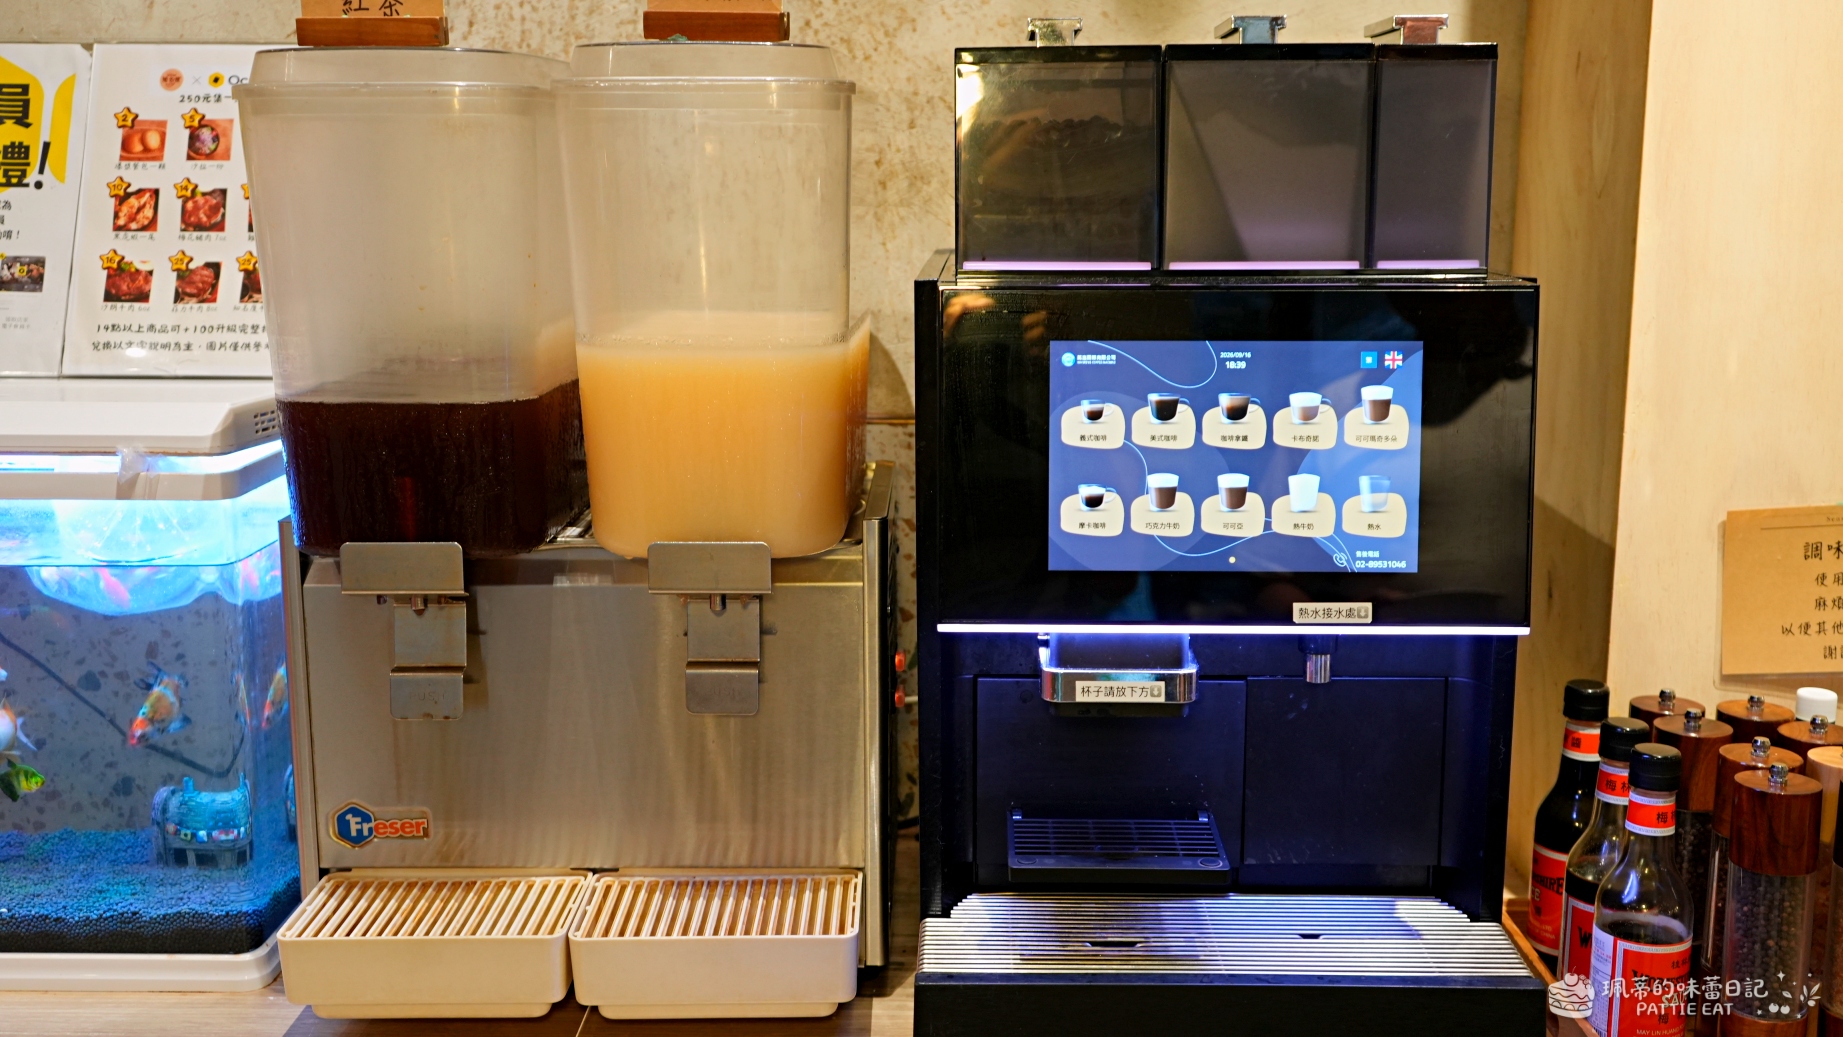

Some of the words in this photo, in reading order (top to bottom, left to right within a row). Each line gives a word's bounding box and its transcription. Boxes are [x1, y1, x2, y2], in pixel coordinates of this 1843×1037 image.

[179, 94, 233, 103] 250元集一
[105, 256, 116, 264] 16
[174, 257, 184, 265] 25
[1225, 361, 1247, 369] 18:39
[1080, 434, 1107, 442] 義式咖啡
[1150, 434, 1178, 442] 美式咖啡
[1220, 434, 1249, 442] 咖啡拿鐵
[1291, 435, 1320, 443] 卡布奇諾
[1078, 522, 1107, 530] 摩卡咖啡
[1145, 522, 1180, 530] 巧克力牛奶
[1222, 522, 1244, 530] 可可亞
[1293, 523, 1315, 531] 熱牛奶
[1367, 523, 1382, 531] 熱水
[1803, 540, 1843, 561] 調味
[1298, 607, 1357, 620] 熱水接水處
[1823, 645, 1843, 660] 謝
[1081, 686, 1150, 698] 杯子請放下方
[345, 813, 428, 837] Freser
